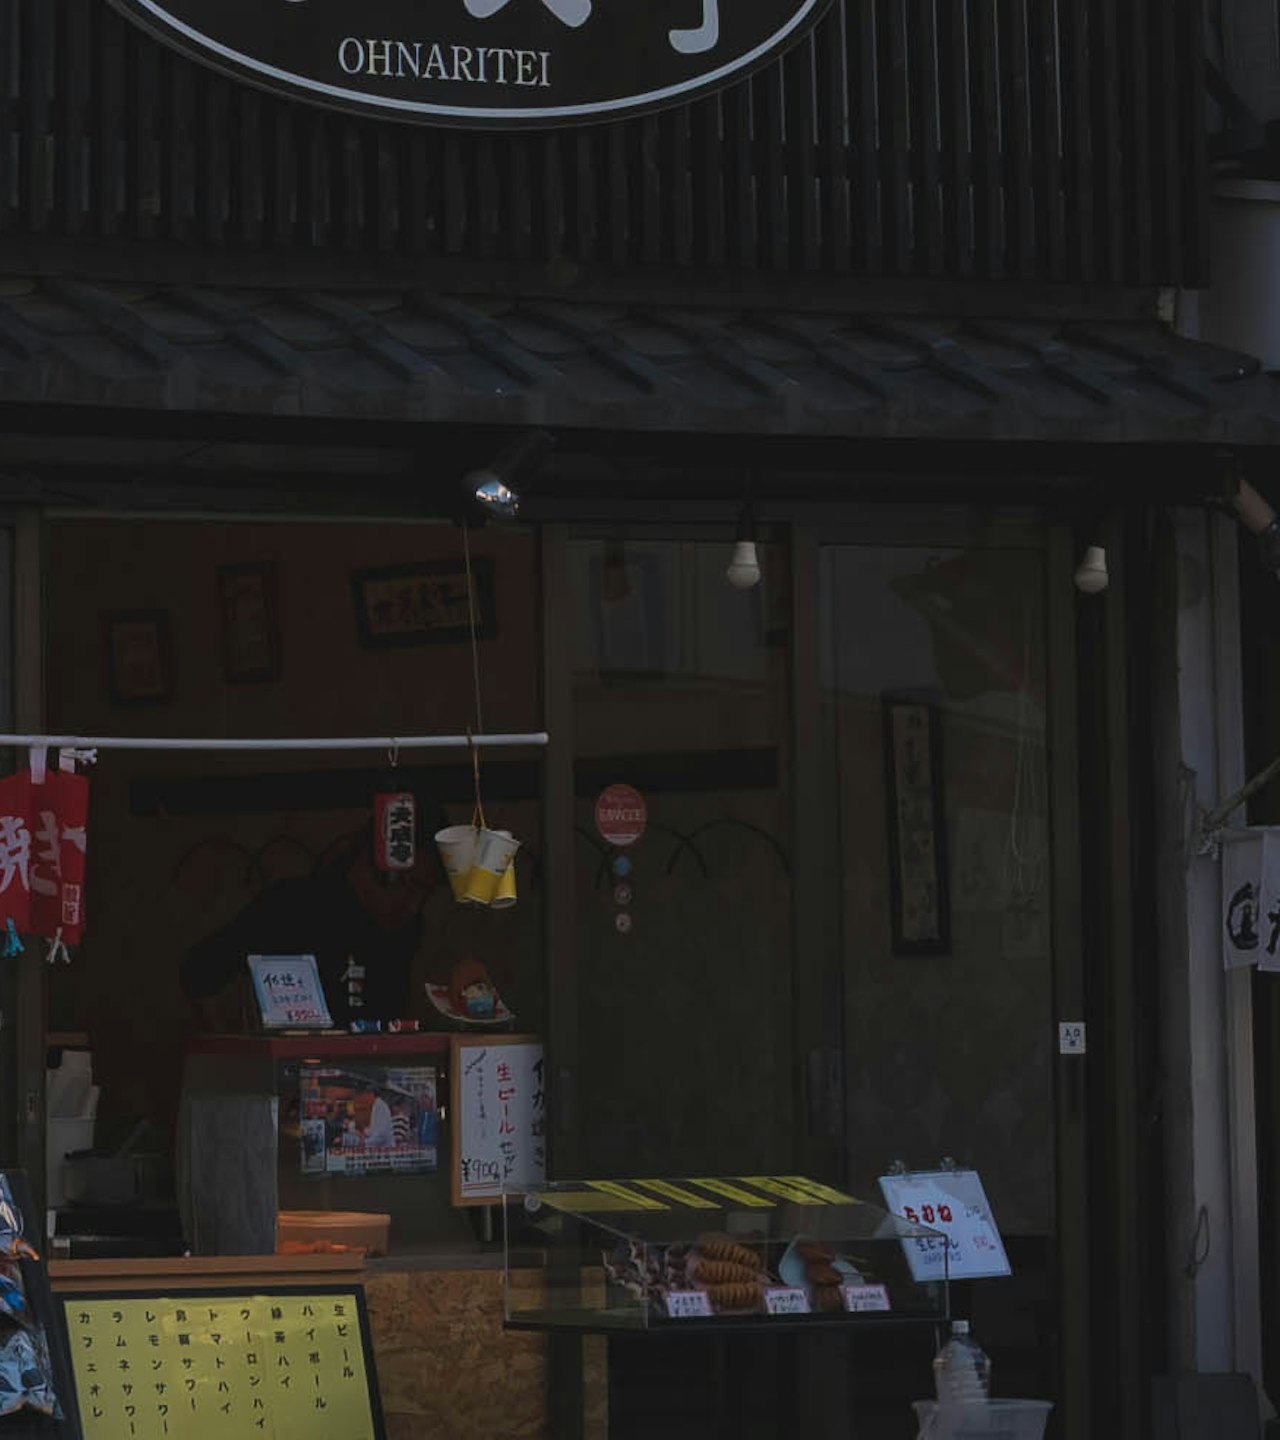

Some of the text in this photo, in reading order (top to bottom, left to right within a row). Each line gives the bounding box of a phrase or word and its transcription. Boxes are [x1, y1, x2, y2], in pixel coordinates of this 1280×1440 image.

[337, 35, 553, 90] OHNARITEI
[495, 1062, 517, 1179] 生ビールセット
[79, 1312, 103, 1418] カフェオレ
[112, 1312, 136, 1435] ラムネサワー
[145, 1311, 169, 1435] レモンサワー
[208, 1309, 232, 1414] トマトハイ
[240, 1308, 265, 1429] ウーロンハイ
[302, 1305, 327, 1409] ハイボール
[334, 1304, 355, 1379] 生ビール
